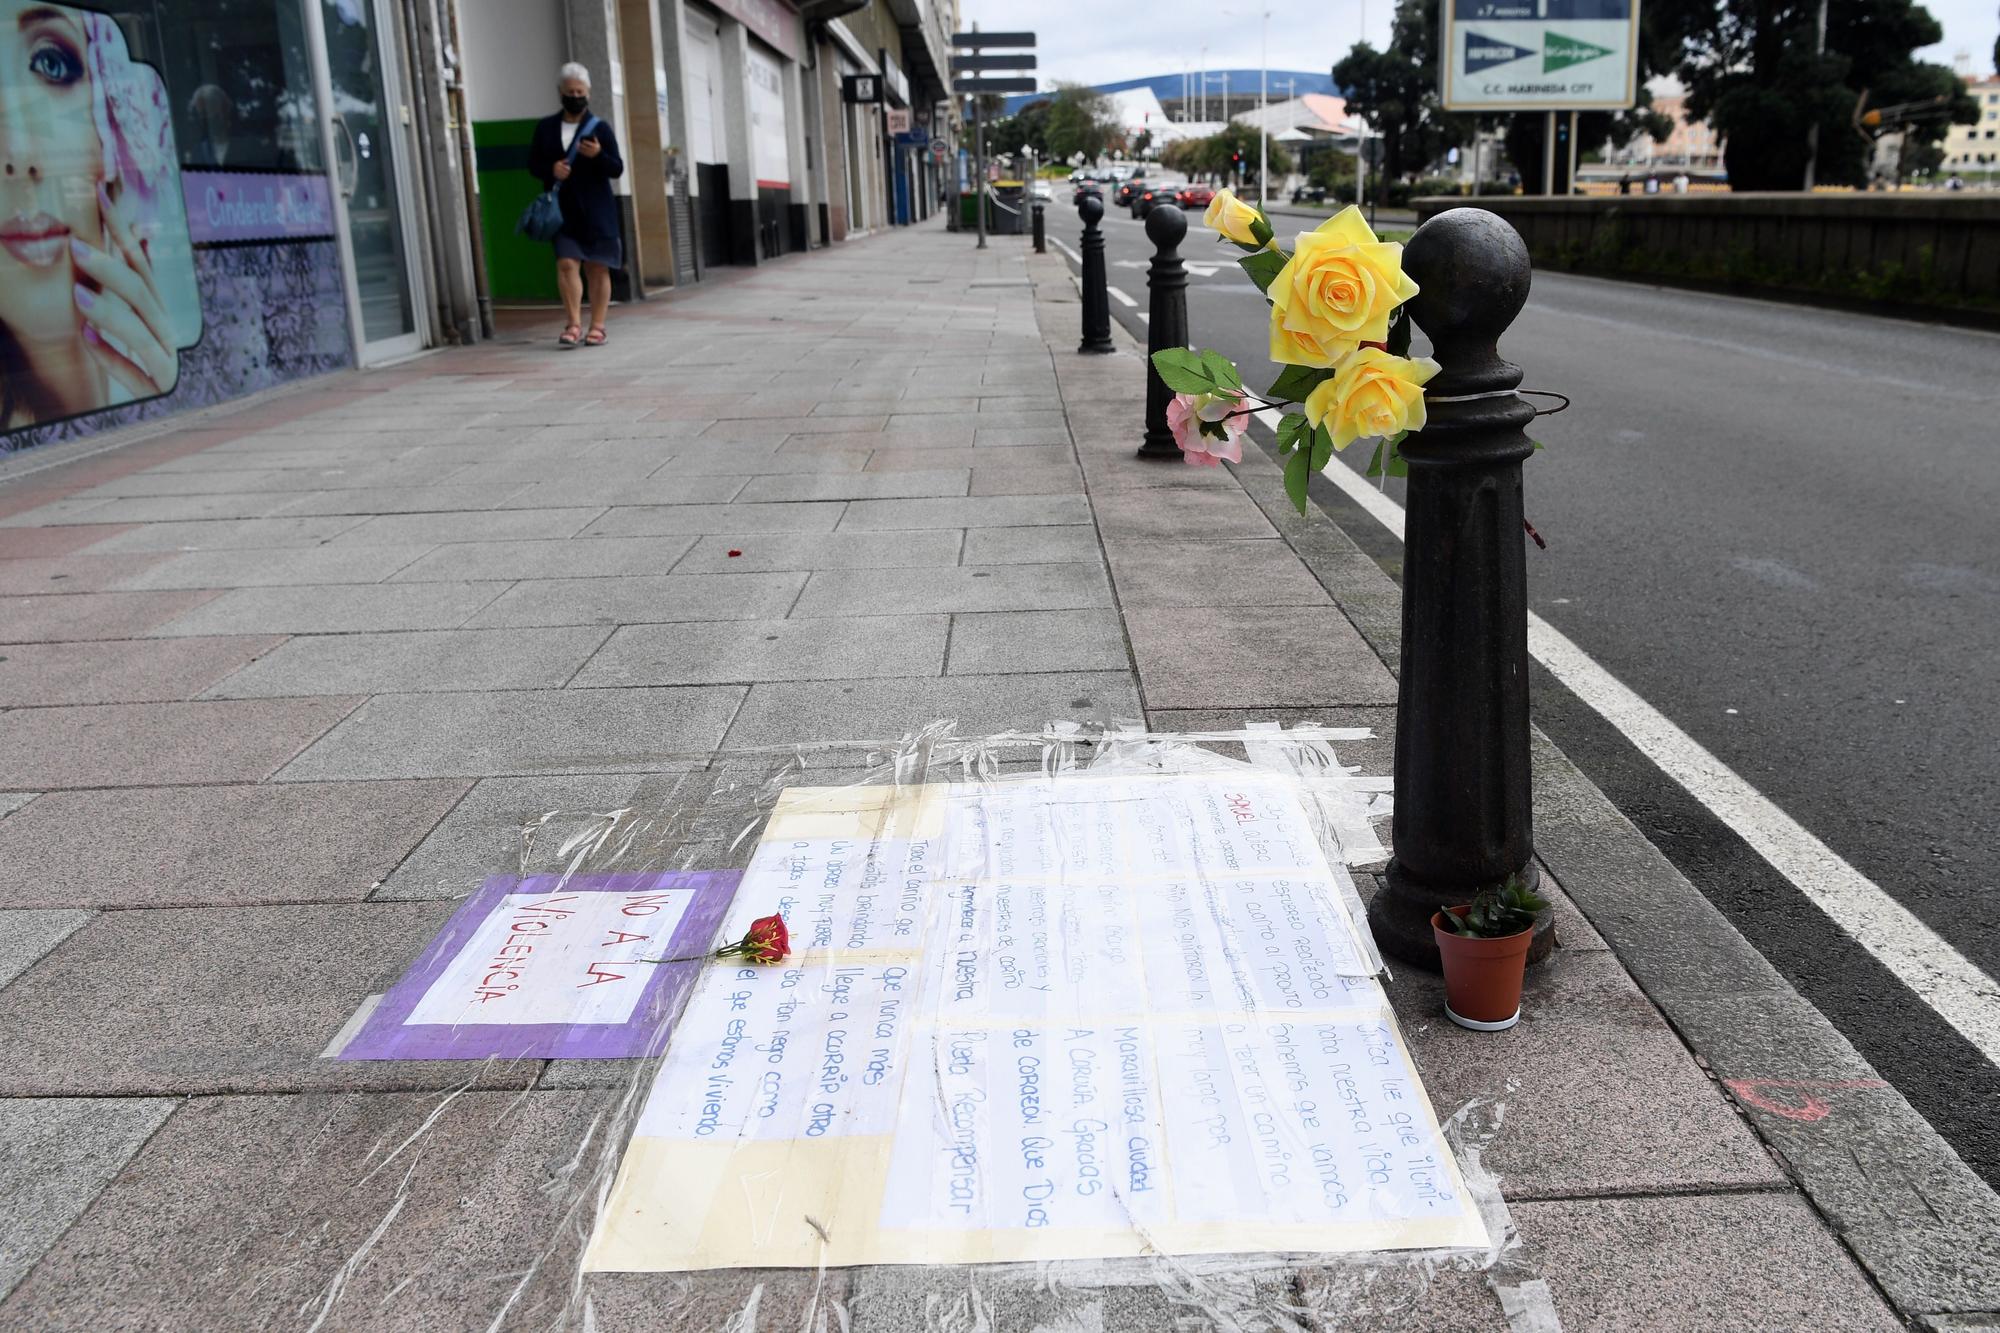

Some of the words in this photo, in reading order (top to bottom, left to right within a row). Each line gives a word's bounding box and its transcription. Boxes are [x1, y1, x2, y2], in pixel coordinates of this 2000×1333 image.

[1486, 5, 1494, 15] 7
[1508, 83, 1566, 95] MARINEDA
[1571, 83, 1594, 93] CITY
[206, 186, 285, 228] Cinderella
[1224, 793, 1259, 826] SAMUEL
[791, 841, 809, 849] a
[789, 856, 814, 880] todos
[909, 865, 927, 874] el
[621, 895, 670, 917] NO
[808, 895, 836, 912] muy
[882, 919, 913, 935] que
[1168, 908, 1193, 928] Nos
[1236, 881, 1255, 893] en
[1265, 946, 1288, 957] al
[602, 931, 650, 946] A
[960, 934, 973, 943] a
[577, 961, 638, 989] LA
[736, 969, 759, 981] el
[779, 970, 802, 989] día
[822, 968, 865, 1004] llegue
[954, 950, 979, 1001] nuestra
[1029, 984, 1052, 992] y
[1179, 991, 1211, 1000] la
[723, 991, 753, 1011] que
[776, 999, 805, 1022] tan
[828, 1012, 845, 1021] a
[878, 1000, 901, 1038] nunca
[1013, 1029, 1038, 1048] de
[1064, 1029, 1094, 1041] A
[1226, 1024, 1245, 1034] a
[1313, 1024, 1343, 1054] naba
[711, 1019, 752, 1069] estamos
[754, 1030, 791, 1064] negro
[1176, 1029, 1207, 1058] muy
[1233, 1044, 1261, 1077] tener
[758, 1071, 782, 1118] como
[1181, 1069, 1221, 1104] largo
[1244, 1086, 1266, 1104] un
[1379, 1078, 1403, 1101] luz
[1377, 1112, 1420, 1146] que
[943, 1088, 986, 1213] Recompensar
[1021, 1136, 1053, 1169] Que
[1253, 1113, 1292, 1187] camino
[1285, 1101, 1321, 1128] que
[1308, 1143, 1348, 1209] vamos
[1023, 1179, 1053, 1228] Dios
